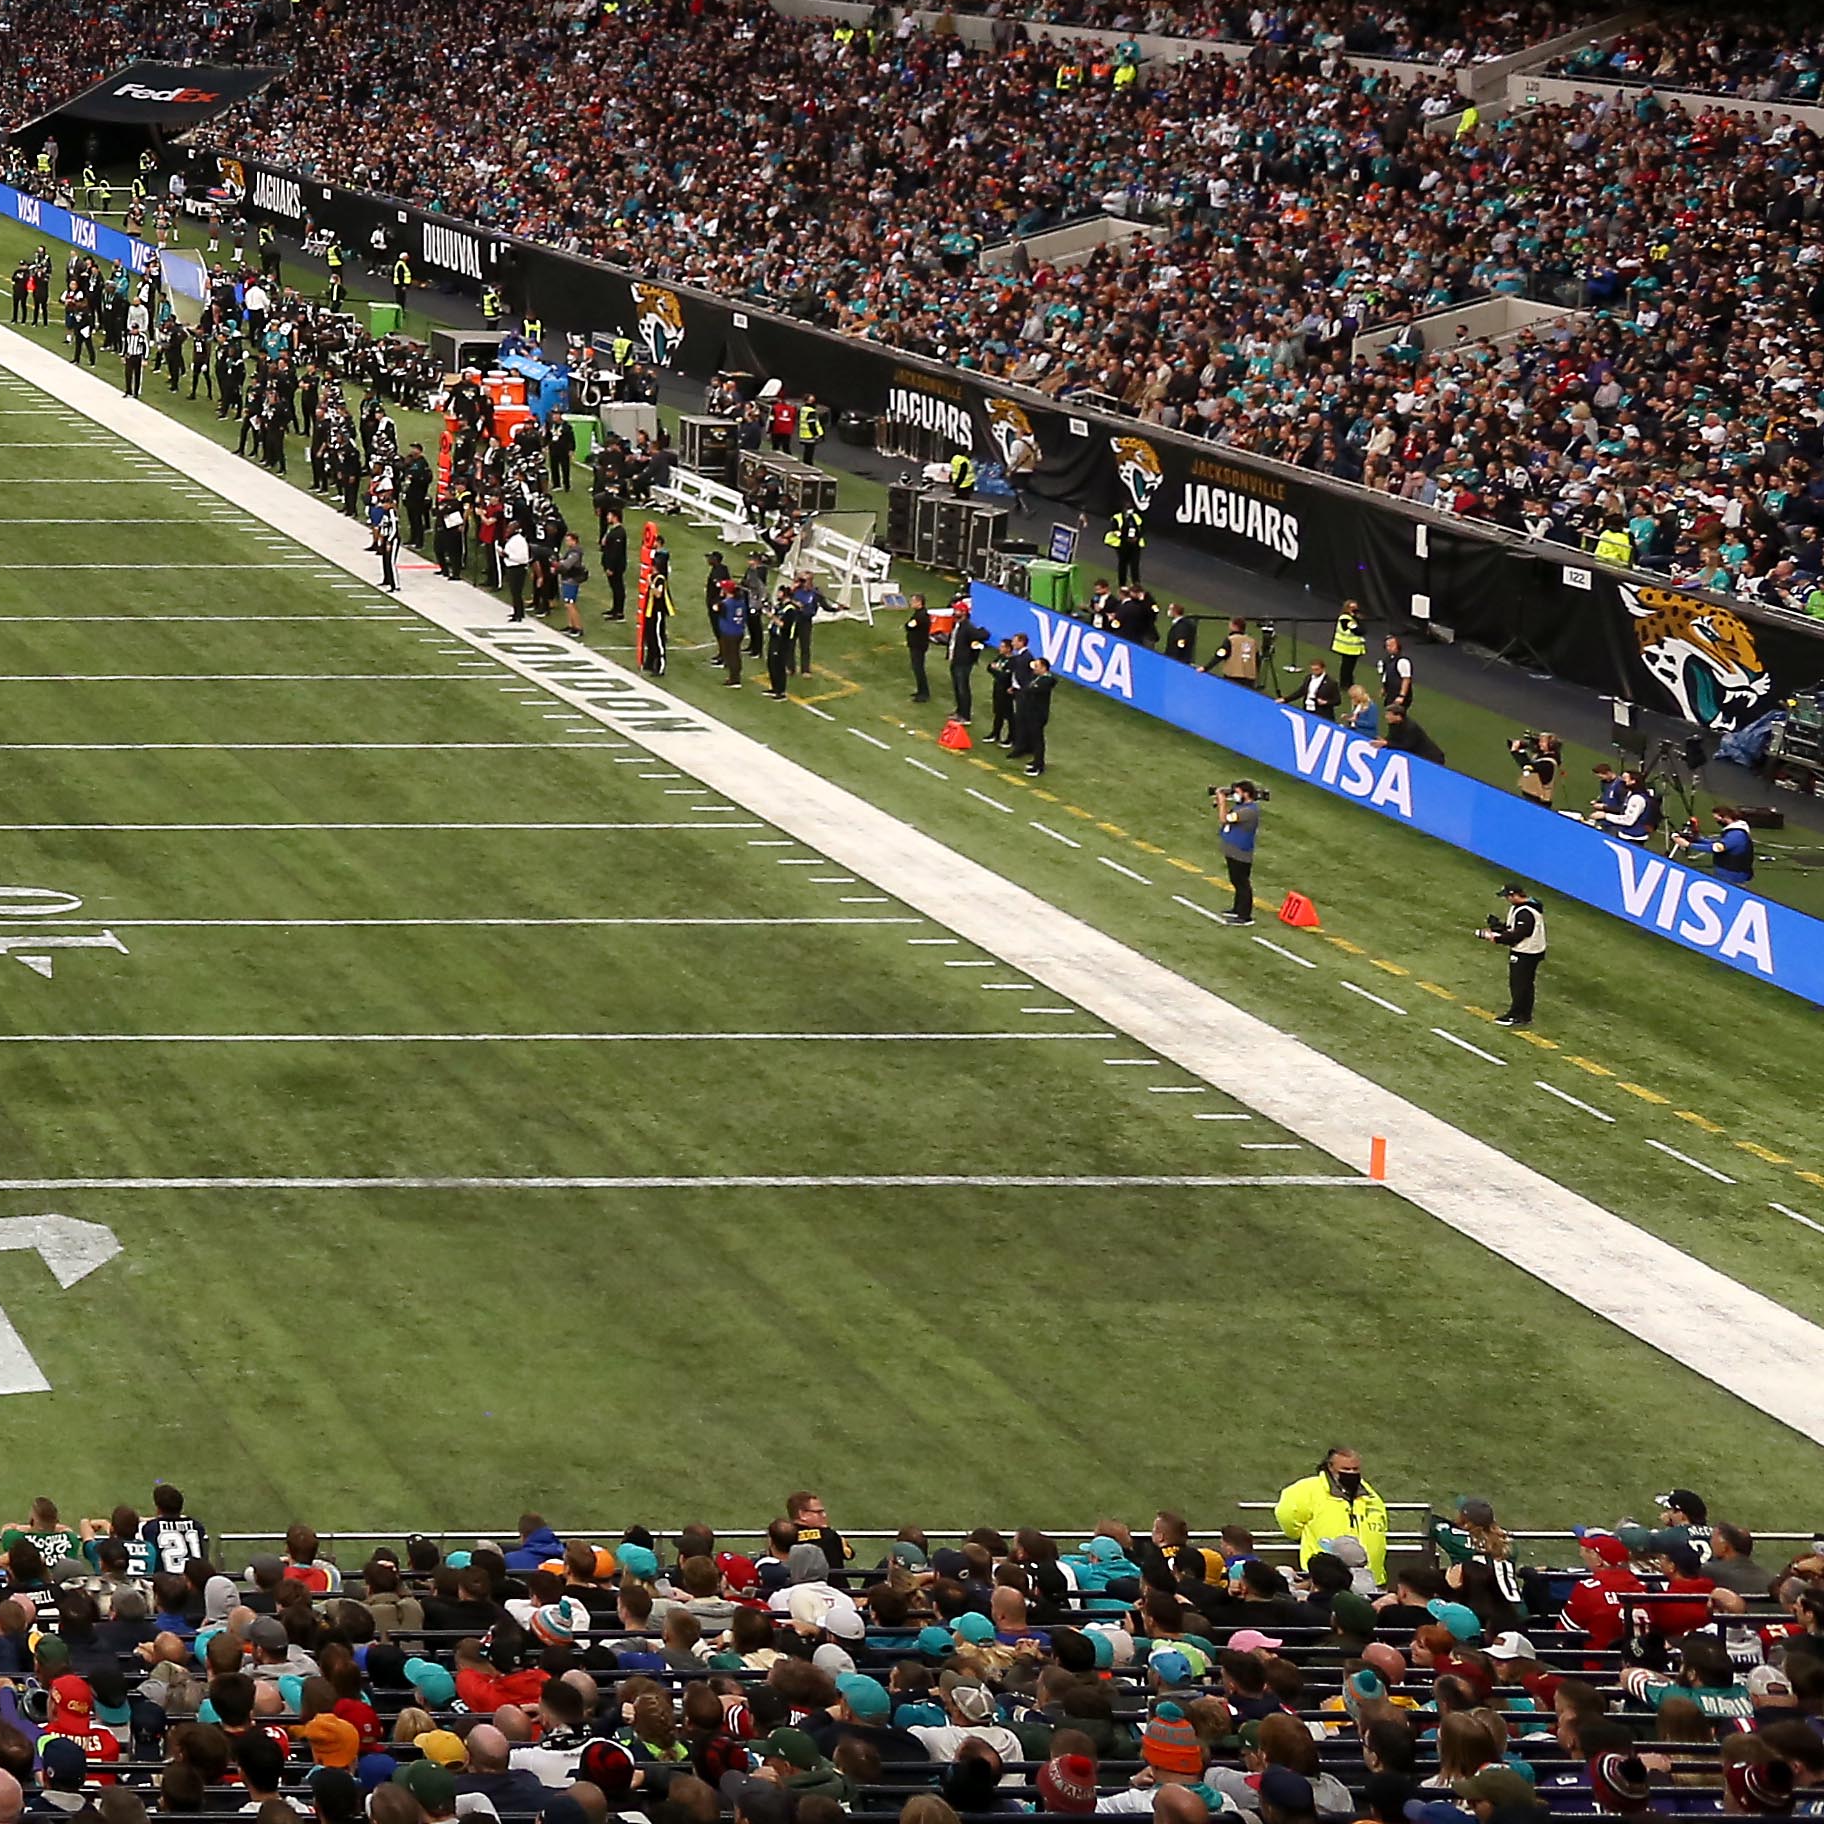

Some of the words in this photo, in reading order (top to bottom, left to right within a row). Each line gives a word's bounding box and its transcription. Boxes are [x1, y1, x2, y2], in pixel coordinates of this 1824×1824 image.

[113, 82, 221, 104] FedEx
[15, 192, 41, 227] VISA
[254, 171, 301, 219] JAGUARS
[69, 213, 98, 251] VISA
[422, 221, 482, 280] DUUUVAL
[887, 388, 974, 452] JAGUARS
[1190, 461, 1287, 503] JACKSONVILLE
[1176, 482, 1300, 561] JAGUARS
[1567, 570, 1586, 586] 122
[1029, 607, 1134, 700] VISA
[463, 626, 711, 733] LONDON
[1279, 708, 1413, 819] VISA
[1283, 897, 1300, 919] 10
[1604, 839, 1773, 975] VISA
[157, 1529, 202, 1576] 21
